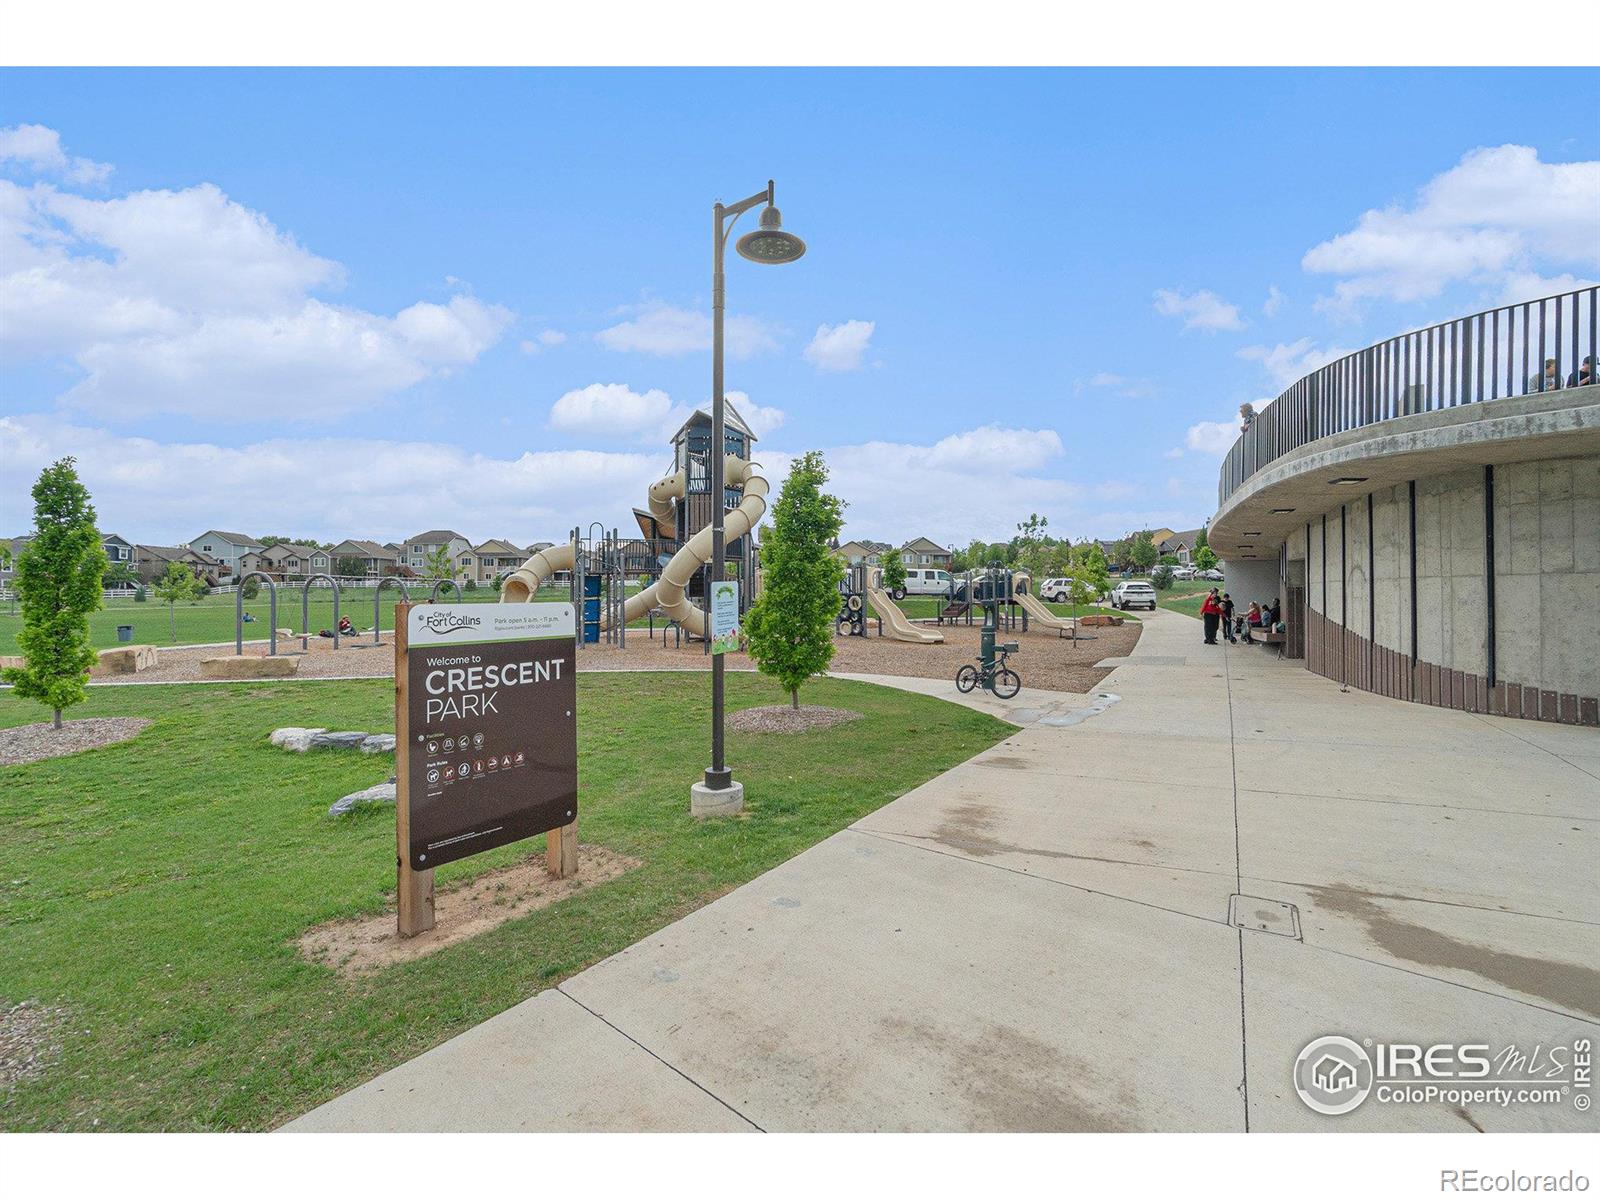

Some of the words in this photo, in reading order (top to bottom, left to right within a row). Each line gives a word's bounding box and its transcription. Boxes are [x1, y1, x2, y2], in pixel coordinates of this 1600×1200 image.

[427, 616, 447, 626] Fort
[449, 615, 481, 626] Collins
[427, 656, 469, 667] Welcome
[472, 655, 481, 663] to
[425, 658, 565, 695] CRESCENT
[426, 691, 498, 724] PARK
